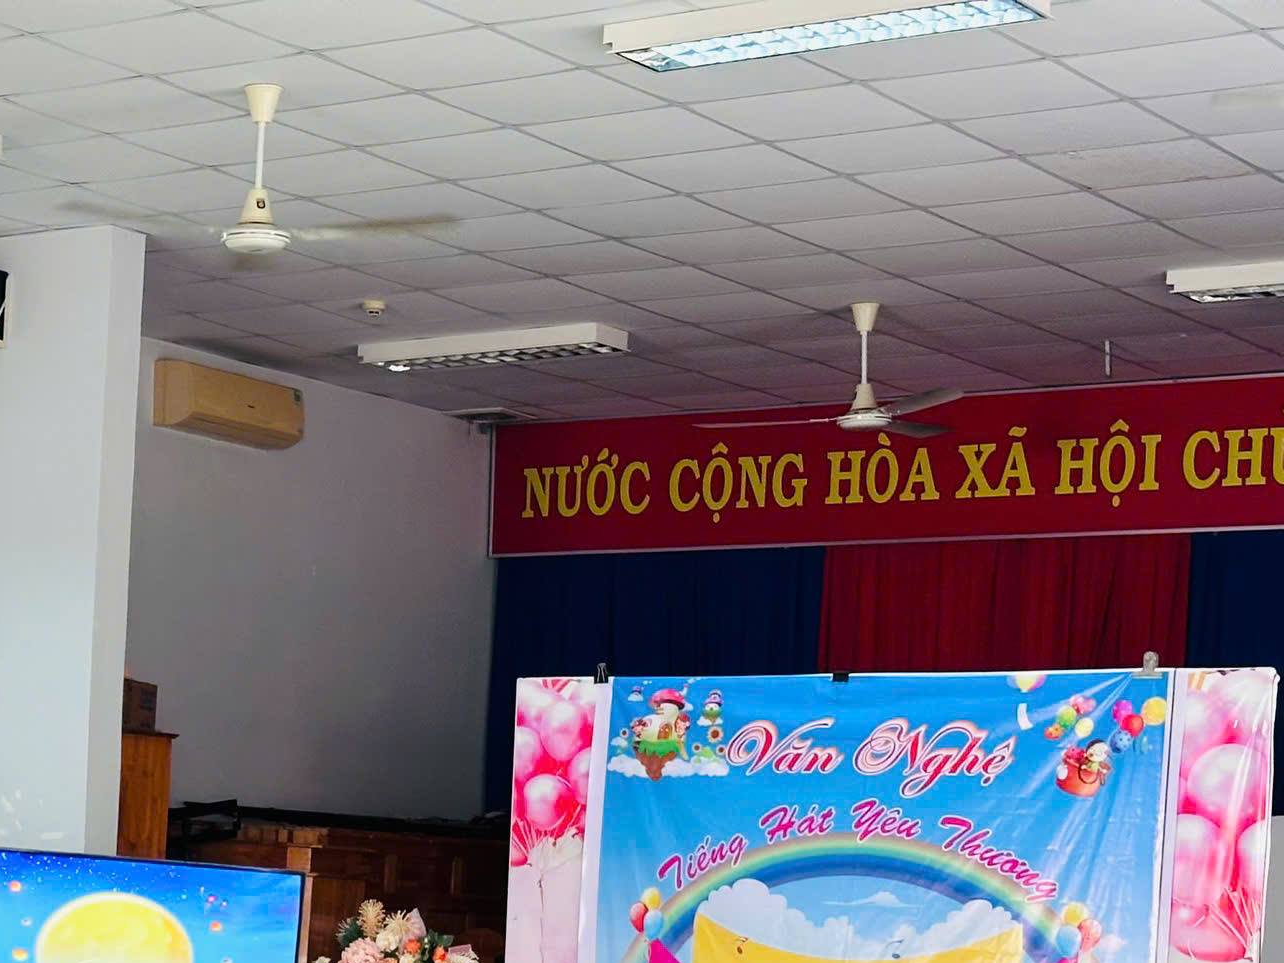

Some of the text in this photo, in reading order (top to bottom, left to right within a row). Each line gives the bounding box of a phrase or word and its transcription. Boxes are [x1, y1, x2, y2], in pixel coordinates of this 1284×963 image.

[521, 447, 651, 519] NƯỚC
[669, 441, 808, 524] CỘNG
[825, 432, 940, 505] HÒA
[955, 425, 1036, 499] XÃ
[1054, 418, 1162, 507] HỘI
[726, 717, 1016, 798] Văn Nghệ
[658, 799, 1057, 902] Tiếng Hát Yêu Thương
